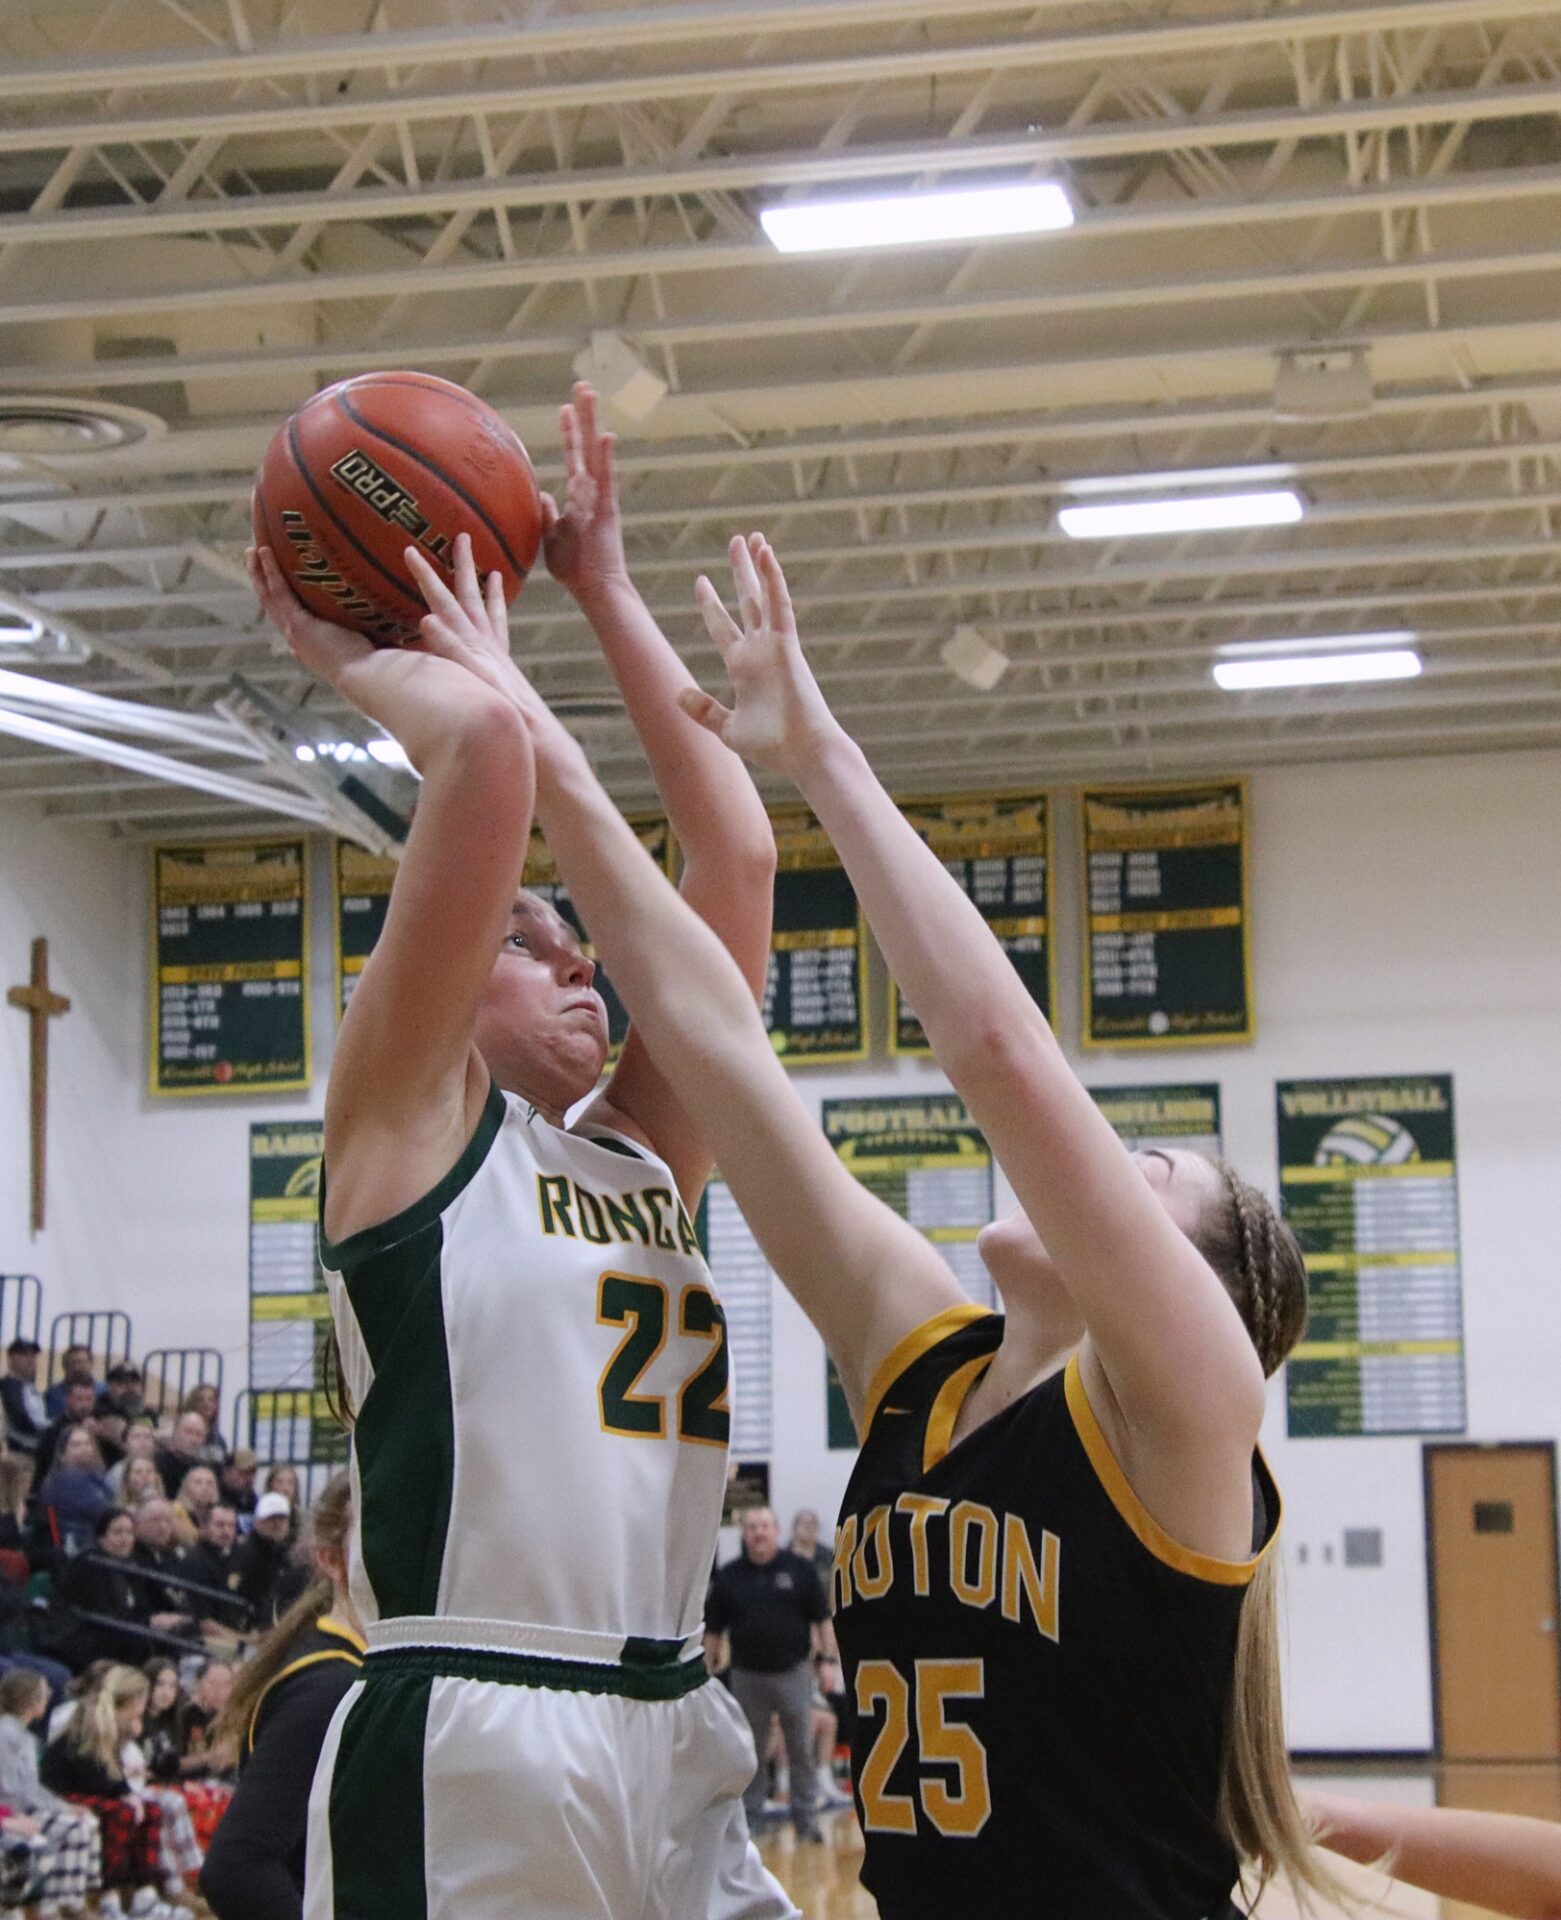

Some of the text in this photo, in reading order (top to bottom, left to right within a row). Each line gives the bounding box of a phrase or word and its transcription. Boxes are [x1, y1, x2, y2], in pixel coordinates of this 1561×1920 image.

[339, 456, 403, 508] PRO
[1281, 1086, 1447, 1116] VOLLEYBALL
[594, 1268, 731, 1449] 22
[852, 1655, 994, 1840] 25
